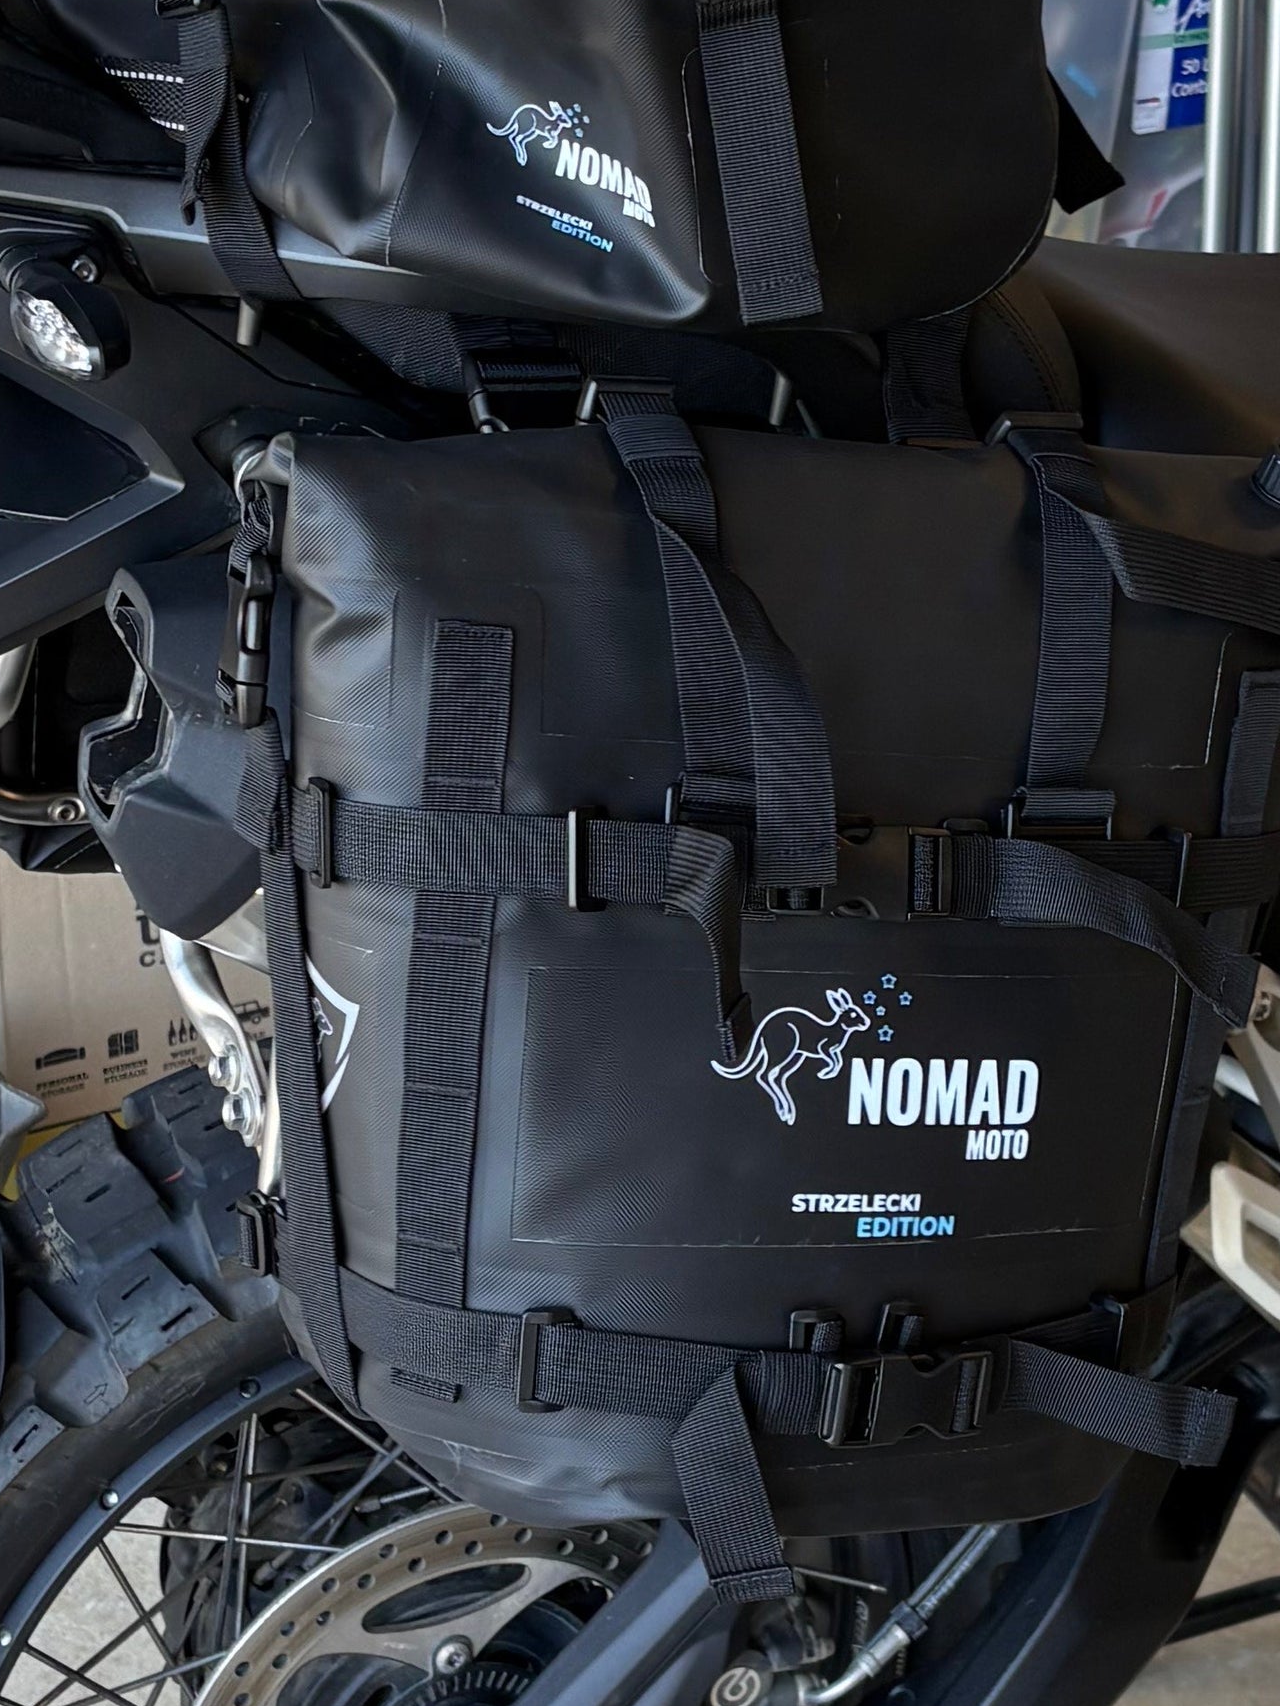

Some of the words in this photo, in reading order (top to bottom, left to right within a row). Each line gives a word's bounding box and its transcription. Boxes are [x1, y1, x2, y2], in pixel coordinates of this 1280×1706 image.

[555, 139, 653, 212] NOMAD
[516, 195, 594, 231] STRZELECKI
[551, 220, 614, 253] EDITION
[847, 1058, 1039, 1127] NOMAD
[965, 1129, 1029, 1160] MOTO
[791, 1193, 921, 1213] STRZELECKI
[856, 1215, 955, 1238] EDITION
